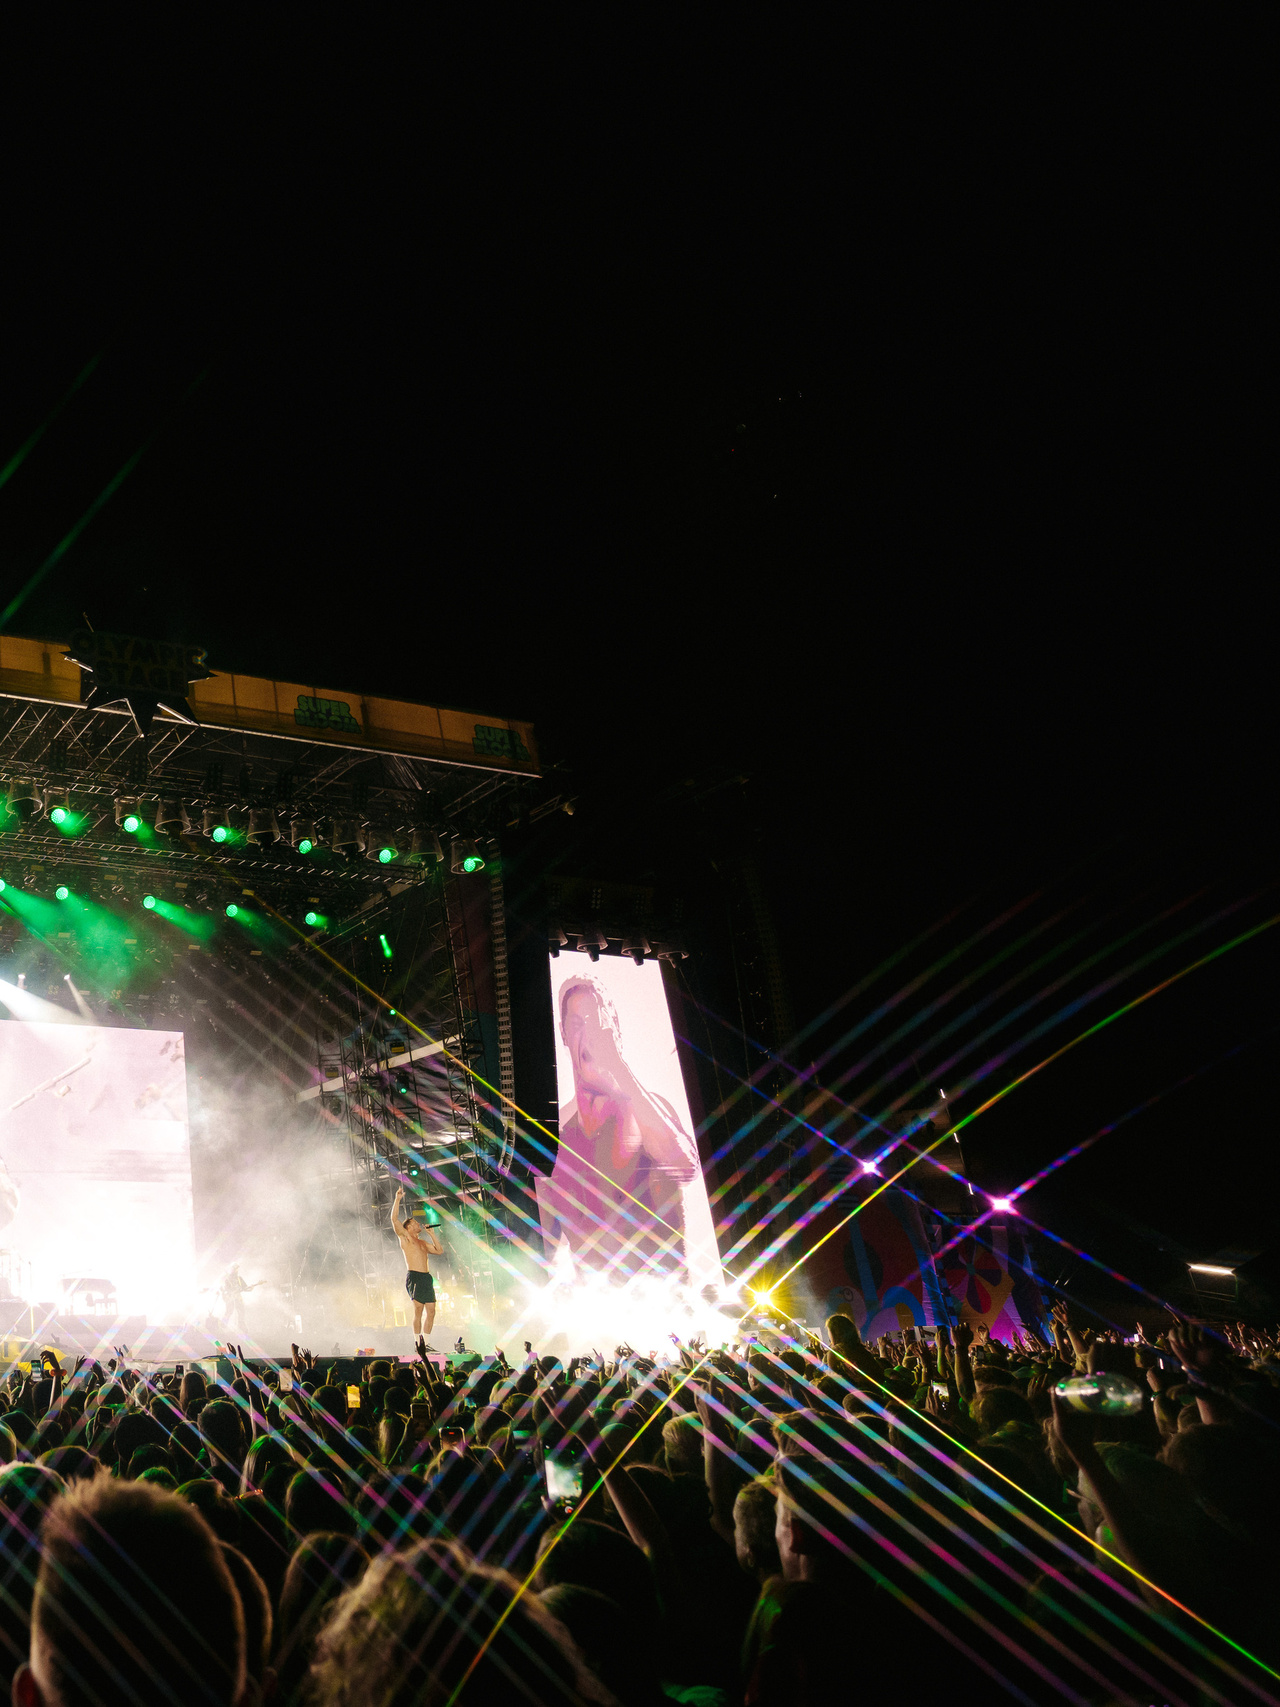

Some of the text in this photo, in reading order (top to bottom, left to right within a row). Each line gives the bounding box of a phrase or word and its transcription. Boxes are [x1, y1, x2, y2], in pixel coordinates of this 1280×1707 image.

[96, 660, 187, 694] STAGE
[297, 695, 352, 717] SUPER
[294, 709, 361, 733] BLOOM
